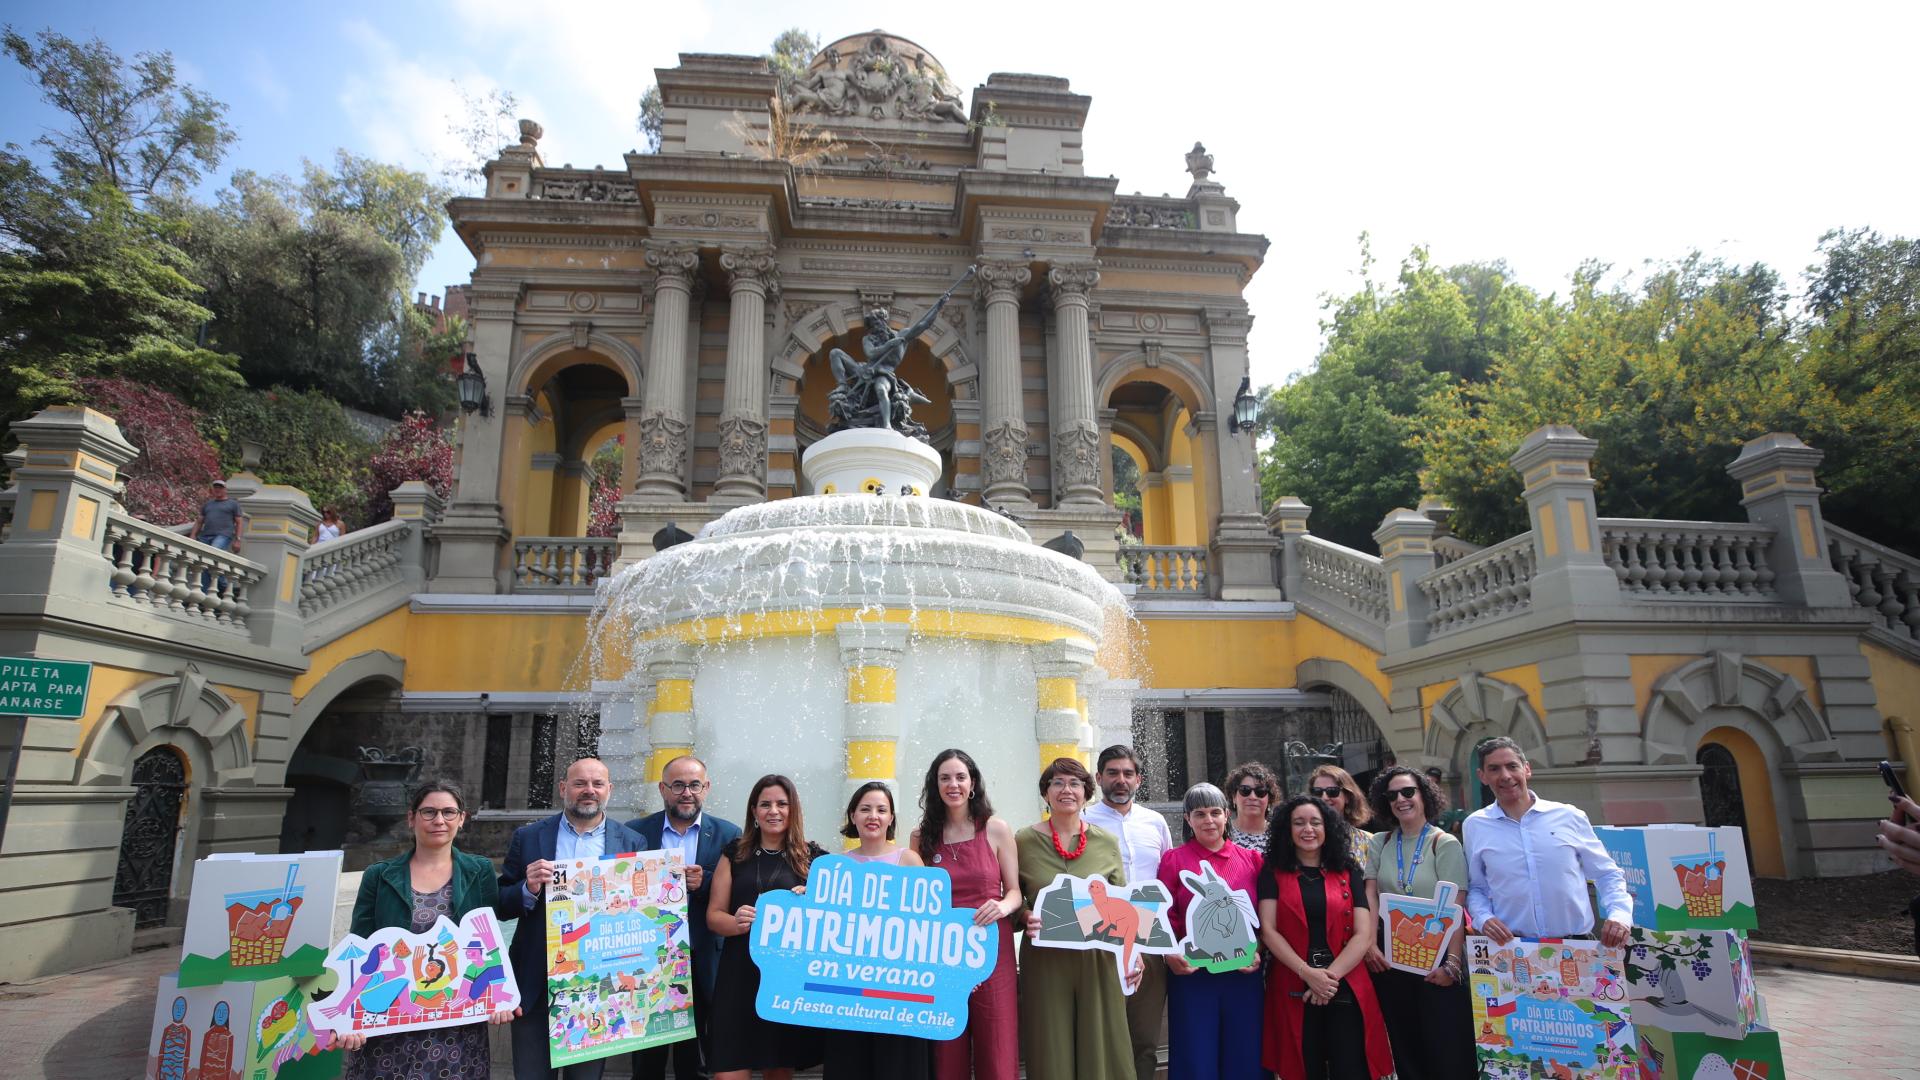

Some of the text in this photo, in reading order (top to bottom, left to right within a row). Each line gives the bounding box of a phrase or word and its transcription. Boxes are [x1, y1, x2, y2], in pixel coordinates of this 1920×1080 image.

[2, 665, 60, 679] PILETA
[0, 681, 83, 696] APTA PARA
[553, 869, 567, 885] 31
[814, 862, 944, 916] DÍA DE LOS
[600, 918, 641, 936] DÍA DE LOS
[1474, 945, 1489, 958] 31
[807, 959, 936, 988] en verano
[771, 995, 956, 1028] La fiesta cultural de Chile
[1527, 1004, 1575, 1022] DÍA DE LOS
[1544, 1035, 1578, 1044] verano
